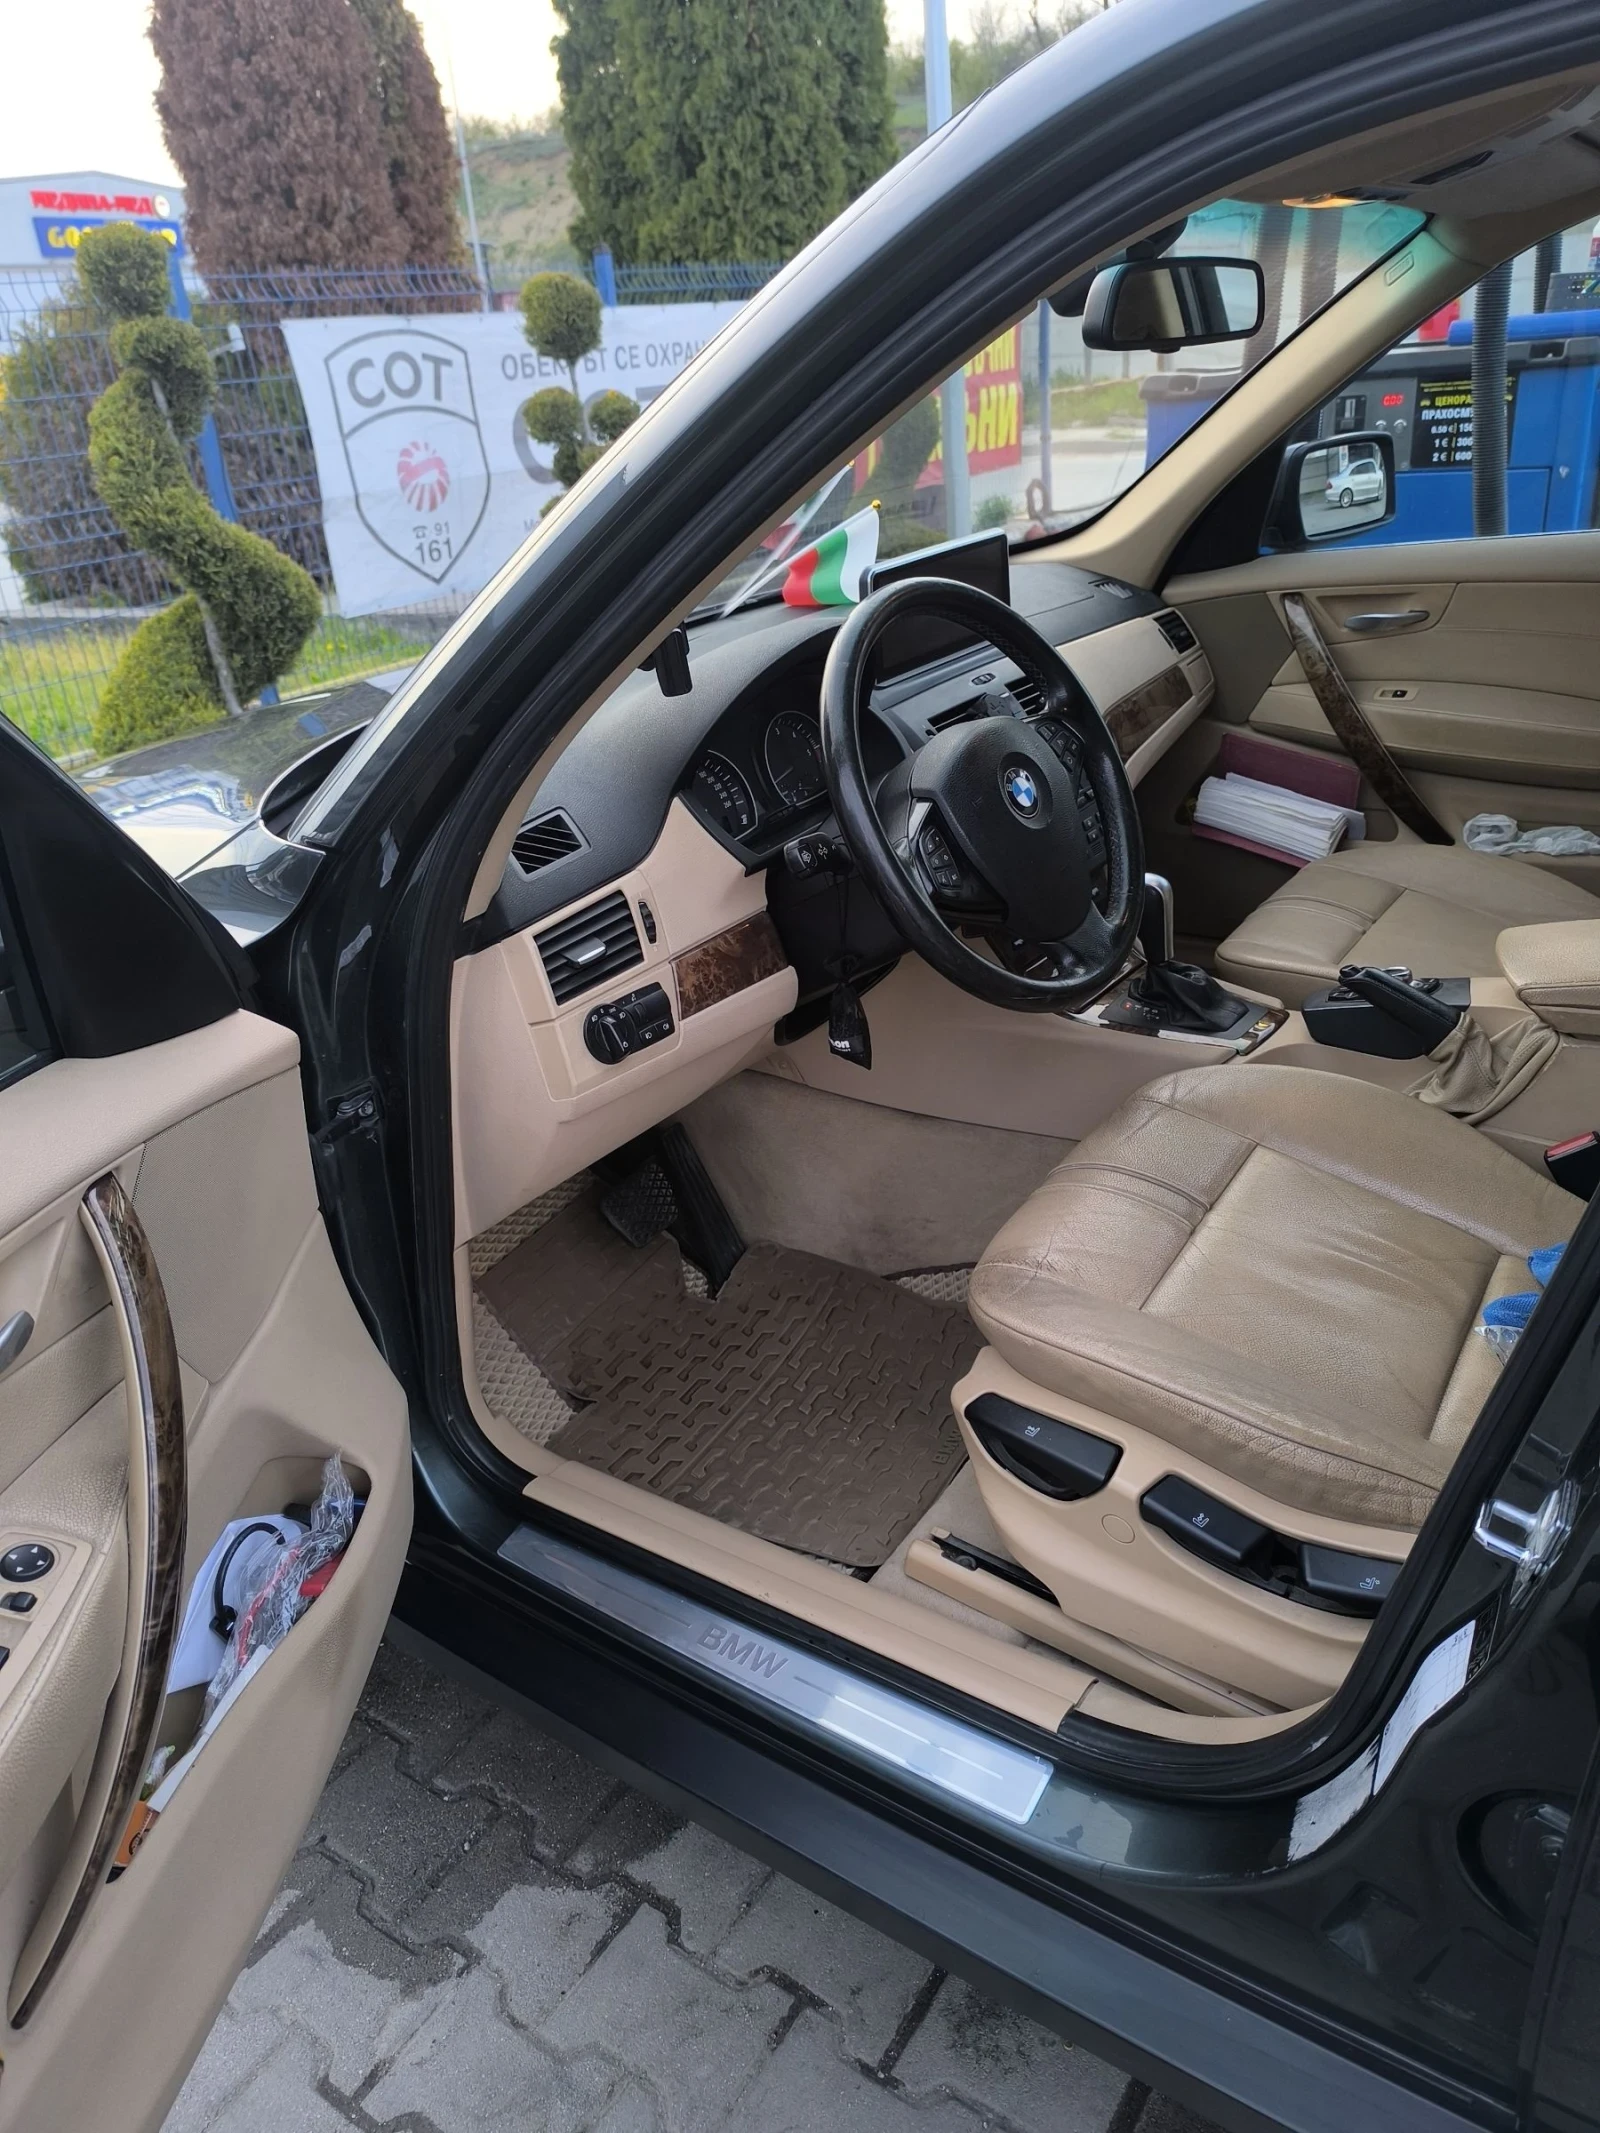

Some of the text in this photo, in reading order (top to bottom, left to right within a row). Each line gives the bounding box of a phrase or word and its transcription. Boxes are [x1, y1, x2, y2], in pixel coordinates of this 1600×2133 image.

[501, 348, 608, 381] ОБЕКЪТ
[614, 345, 641, 371] СЕ
[347, 350, 454, 409] СОТ
[1421, 407, 1474, 420] ПРАХОСМ
[1435, 394, 1474, 407] ЦЕНОРА
[415, 537, 453, 564] 161
[697, 1622, 789, 1679] BMW
